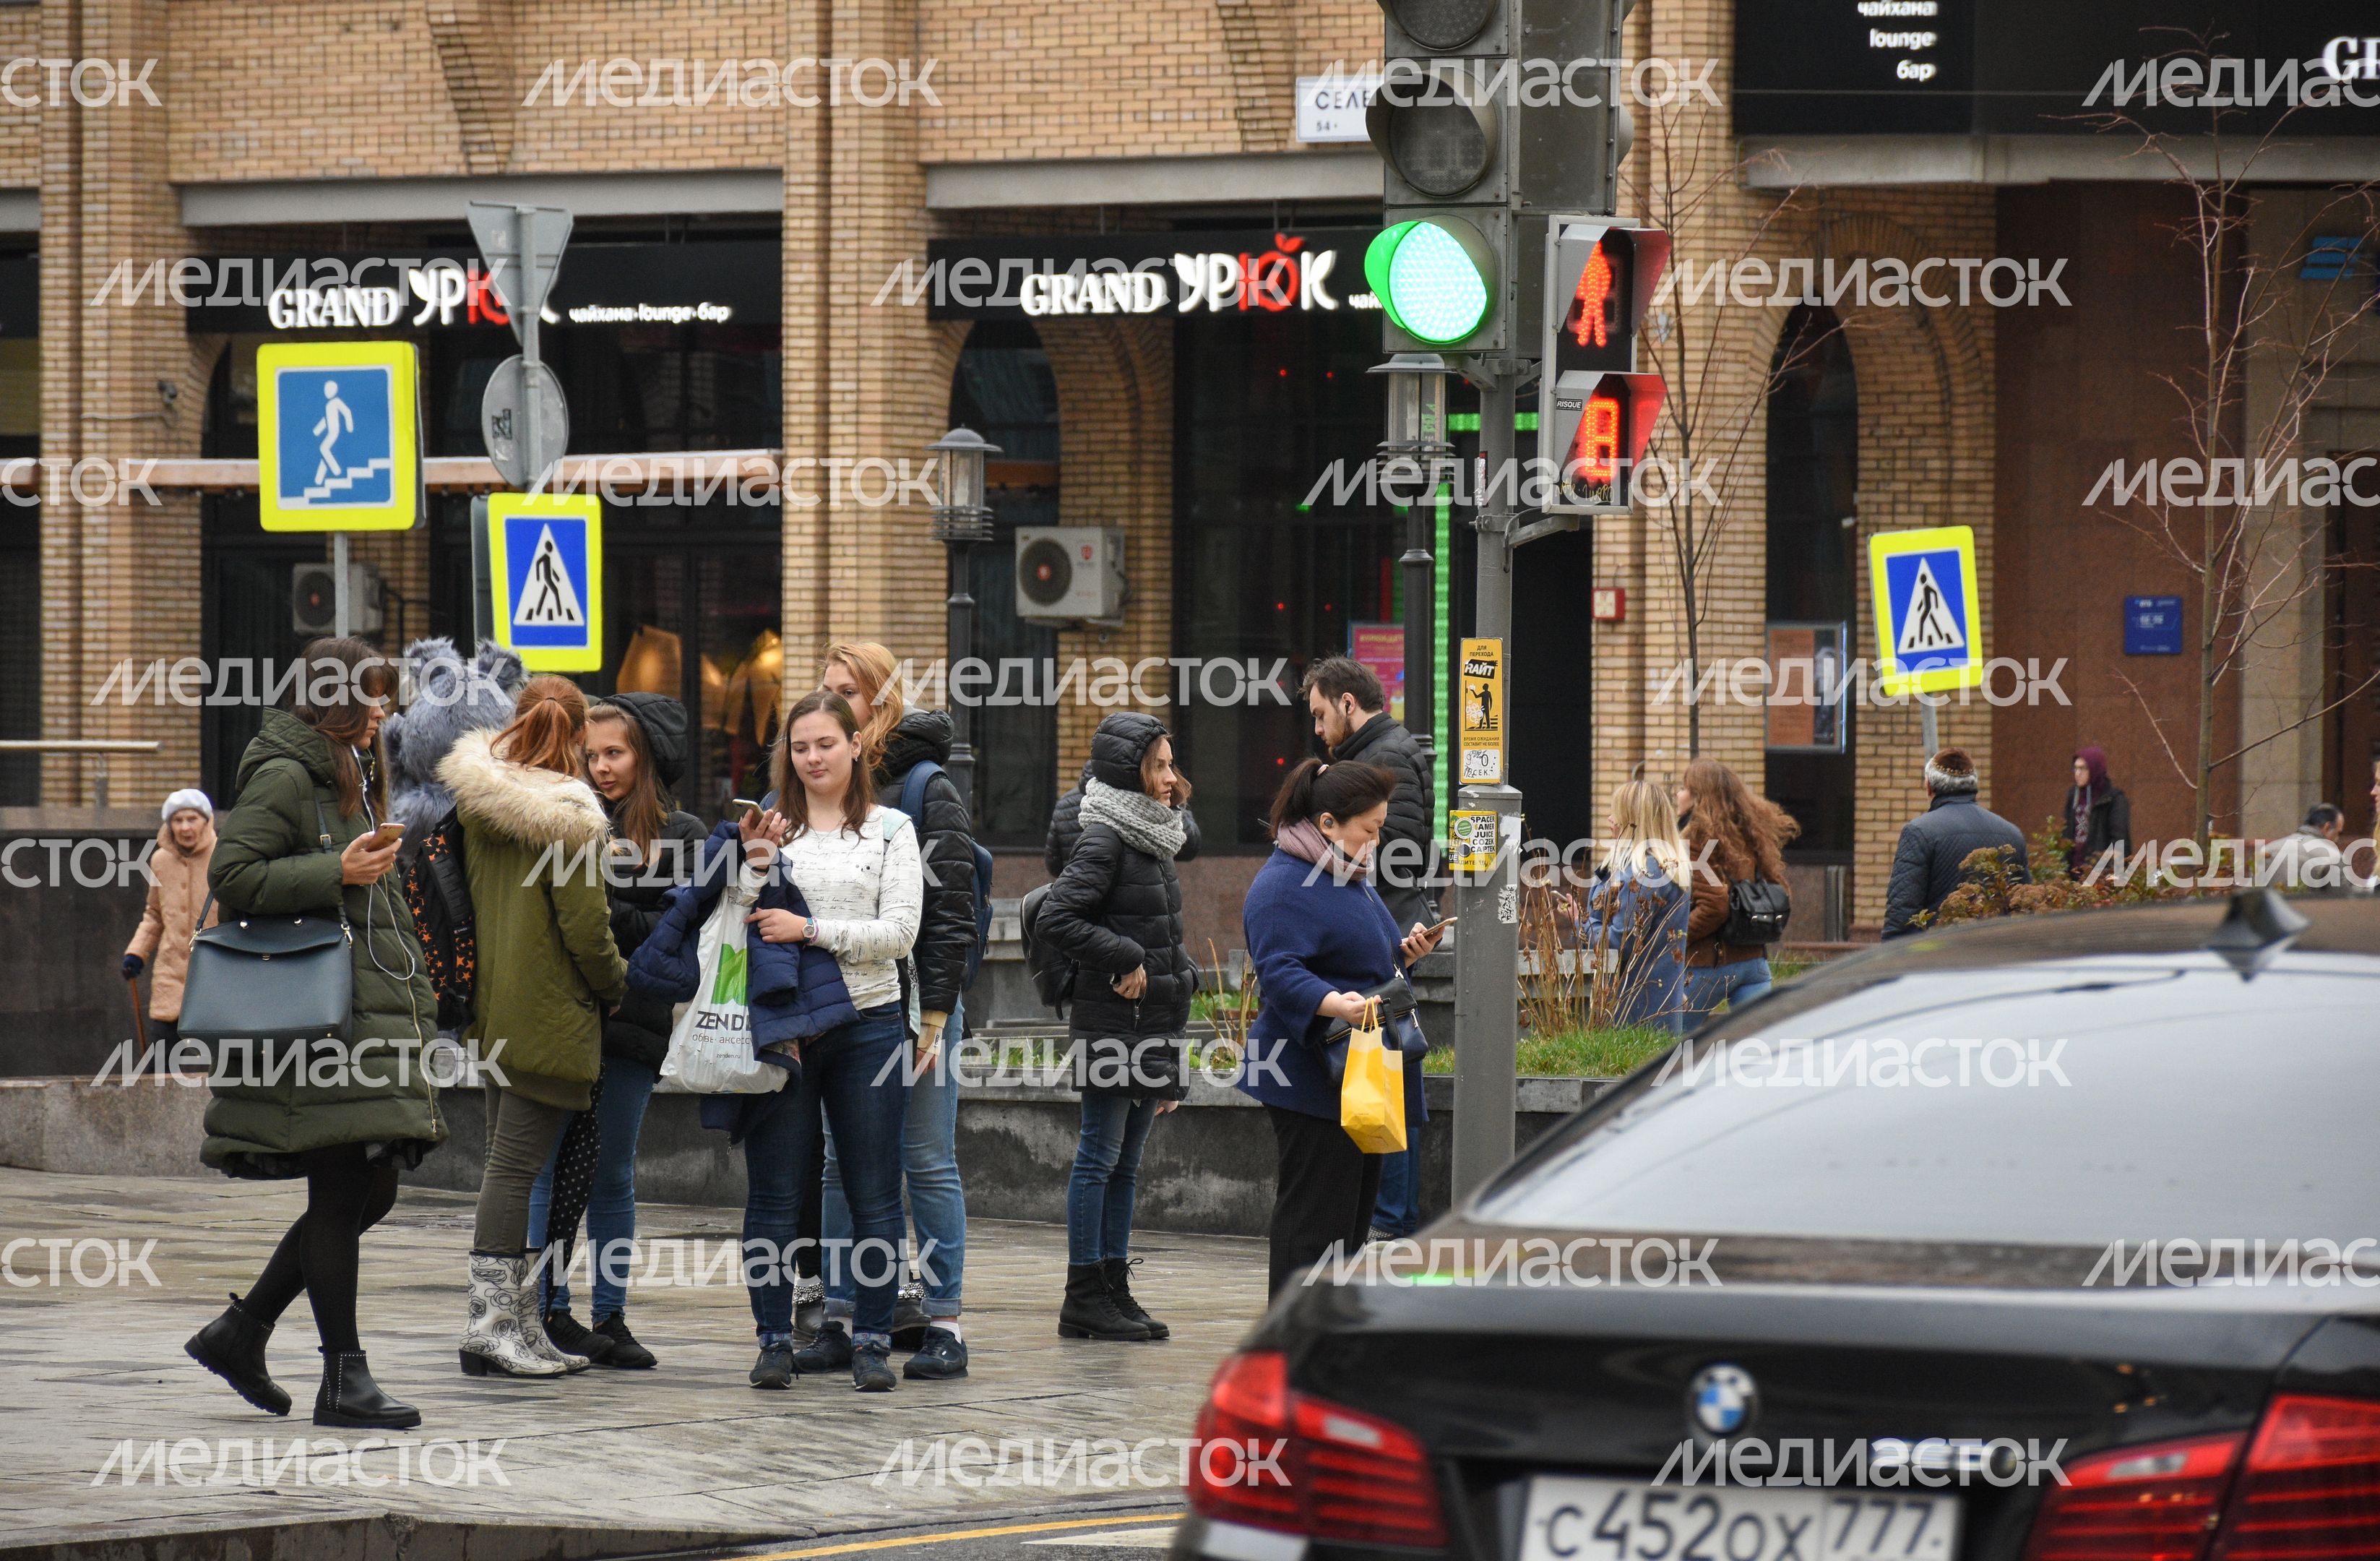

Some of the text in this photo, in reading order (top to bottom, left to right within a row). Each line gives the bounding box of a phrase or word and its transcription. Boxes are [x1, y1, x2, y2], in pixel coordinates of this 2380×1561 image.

[1870, 28, 1937, 50] lounge
[1897, 59, 1936, 82] бар
[268, 286, 402, 329] GRAND
[1021, 272, 1165, 316] GRAND
[1556, 400, 1582, 409] RISQUE
[1833, 1497, 1933, 1555] 777
